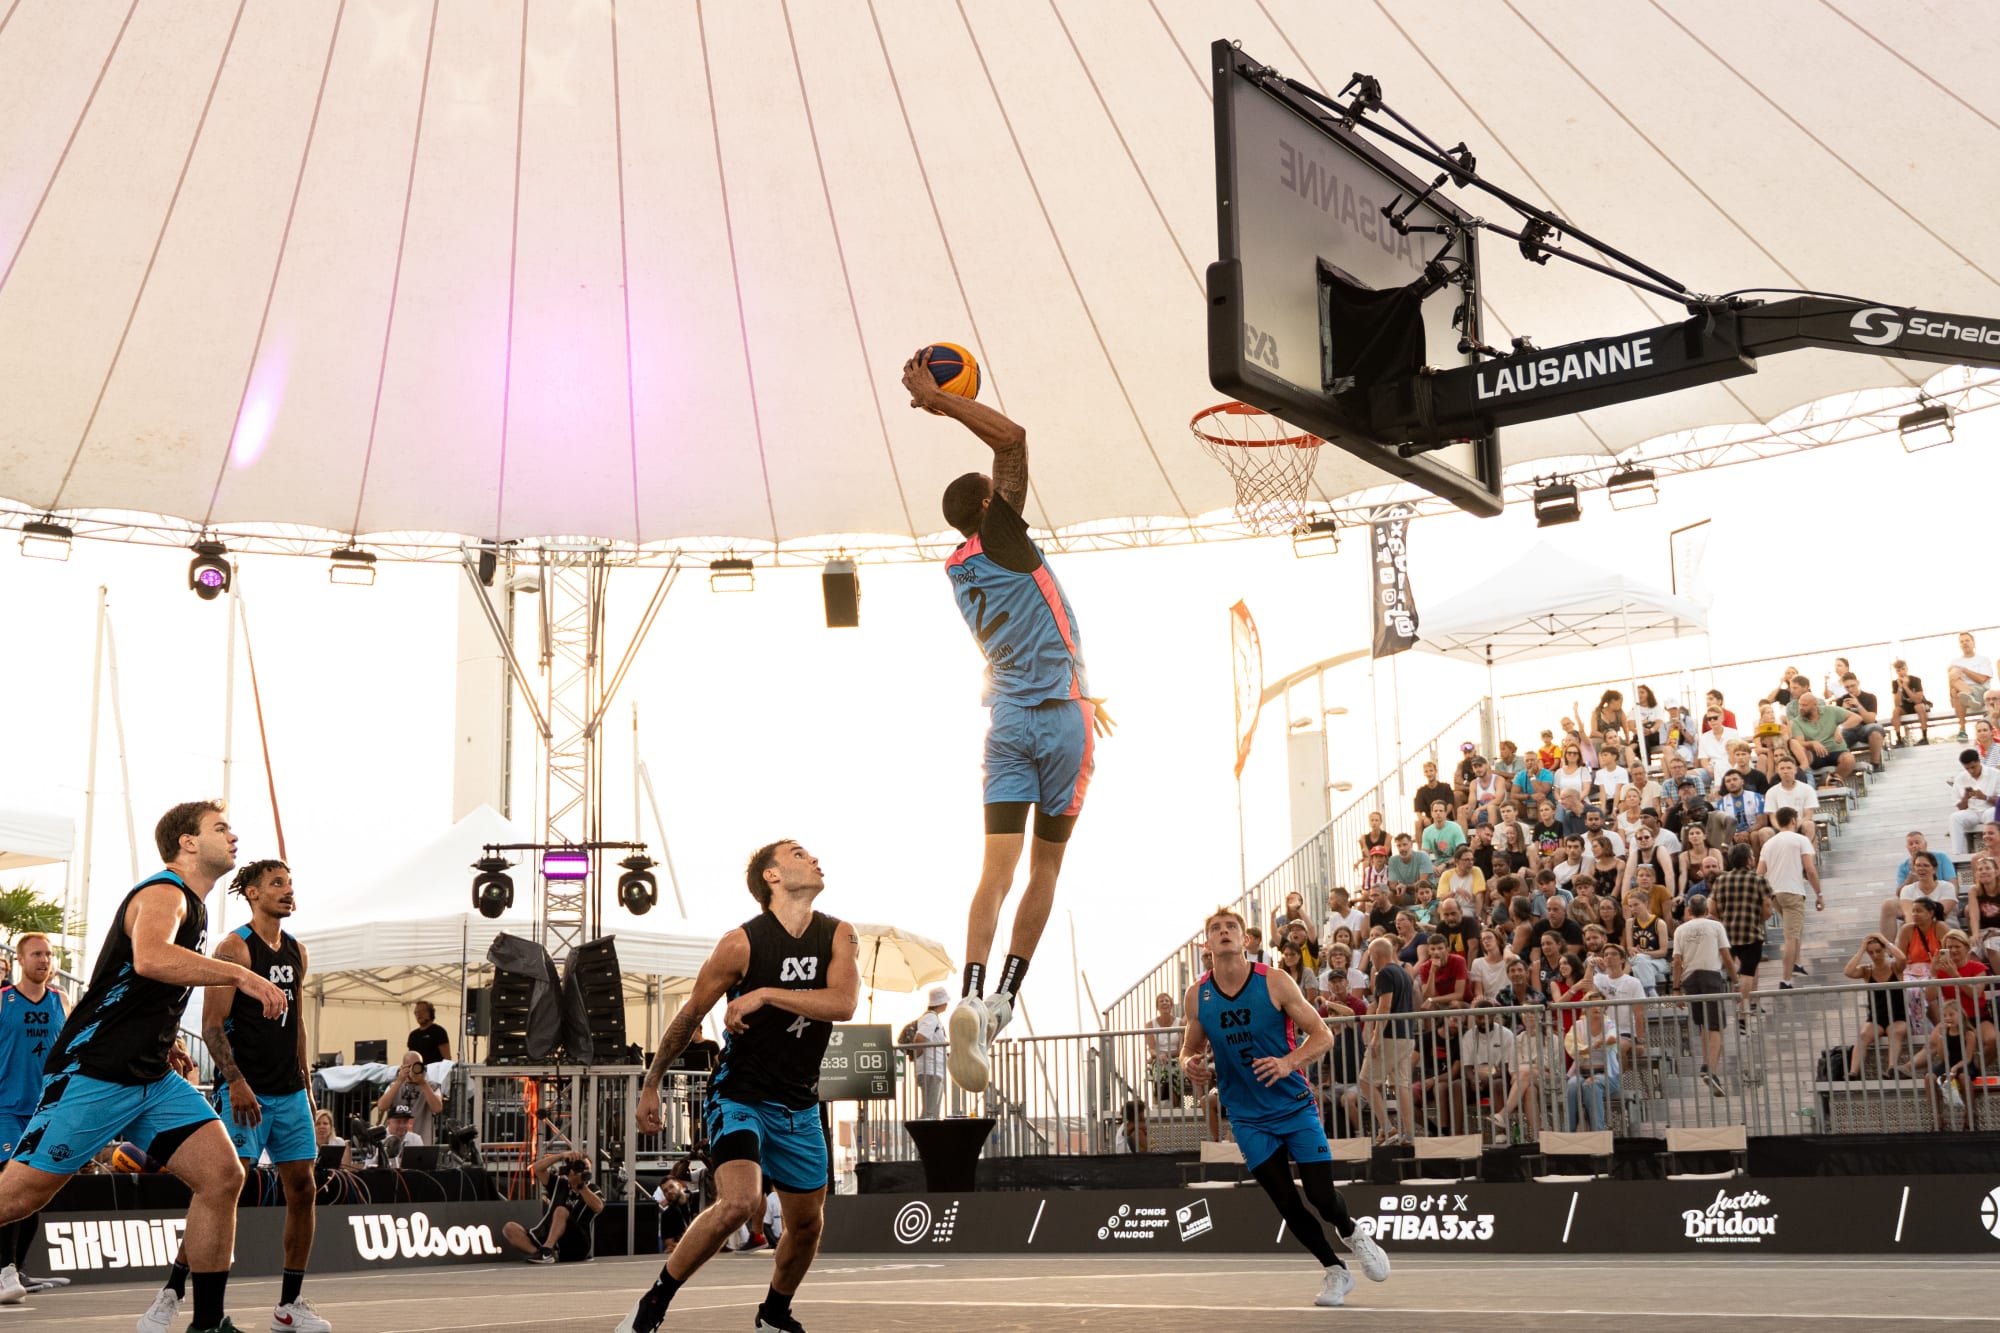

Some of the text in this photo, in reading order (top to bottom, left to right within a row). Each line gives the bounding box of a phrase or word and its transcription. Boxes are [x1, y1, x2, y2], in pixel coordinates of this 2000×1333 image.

[1476, 338, 1653, 400] LAUSANNE
[969, 586, 1010, 643] 2
[26, 1027, 48, 1038] MIAMI
[786, 1015, 811, 1038] 4
[1226, 1033, 1253, 1046] MIAMI
[32, 1041, 46, 1057] 4
[1239, 1048, 1254, 1067] 5
[860, 1054, 882, 1069] 08
[876, 1082, 884, 1091] 5
[1706, 1189, 1770, 1217] Justin
[1135, 1208, 1167, 1216] FONDS
[1357, 1214, 1495, 1241] @FIBA3x3
[1682, 1209, 1778, 1237] Bridou
[1113, 1231, 1154, 1239] VAUDOIS
